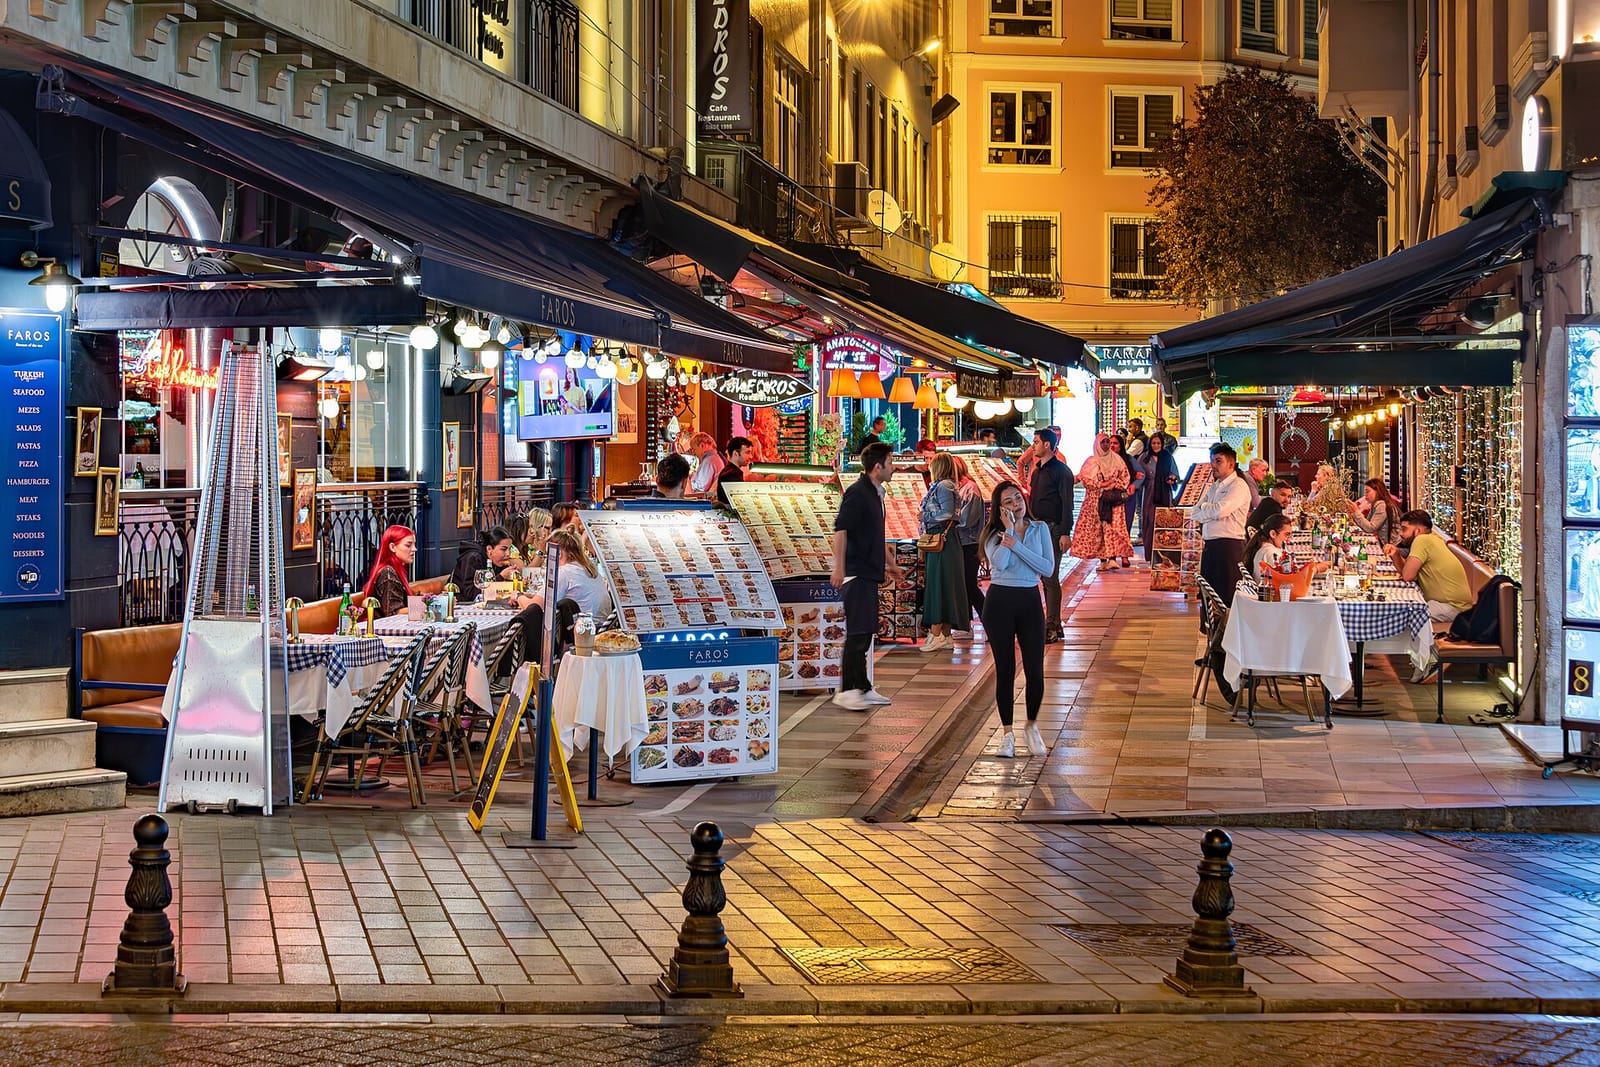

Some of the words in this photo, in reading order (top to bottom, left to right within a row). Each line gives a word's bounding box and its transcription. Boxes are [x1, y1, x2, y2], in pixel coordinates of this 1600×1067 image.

[711, 0, 729, 100] DROS
[709, 104, 728, 112] Cafe
[8, 180, 21, 211] S
[541, 295, 576, 327] FAROS
[8, 329, 50, 342] FAROS
[723, 342, 744, 364] FAROS
[13, 370, 45, 379] TURKISH
[13, 388, 45, 396] SEAFOOD
[7, 478, 50, 486] HAMBURGER
[16, 514, 41, 522] STEAKS
[689, 649, 729, 661] FAROS
[1573, 666, 1590, 693] 8
